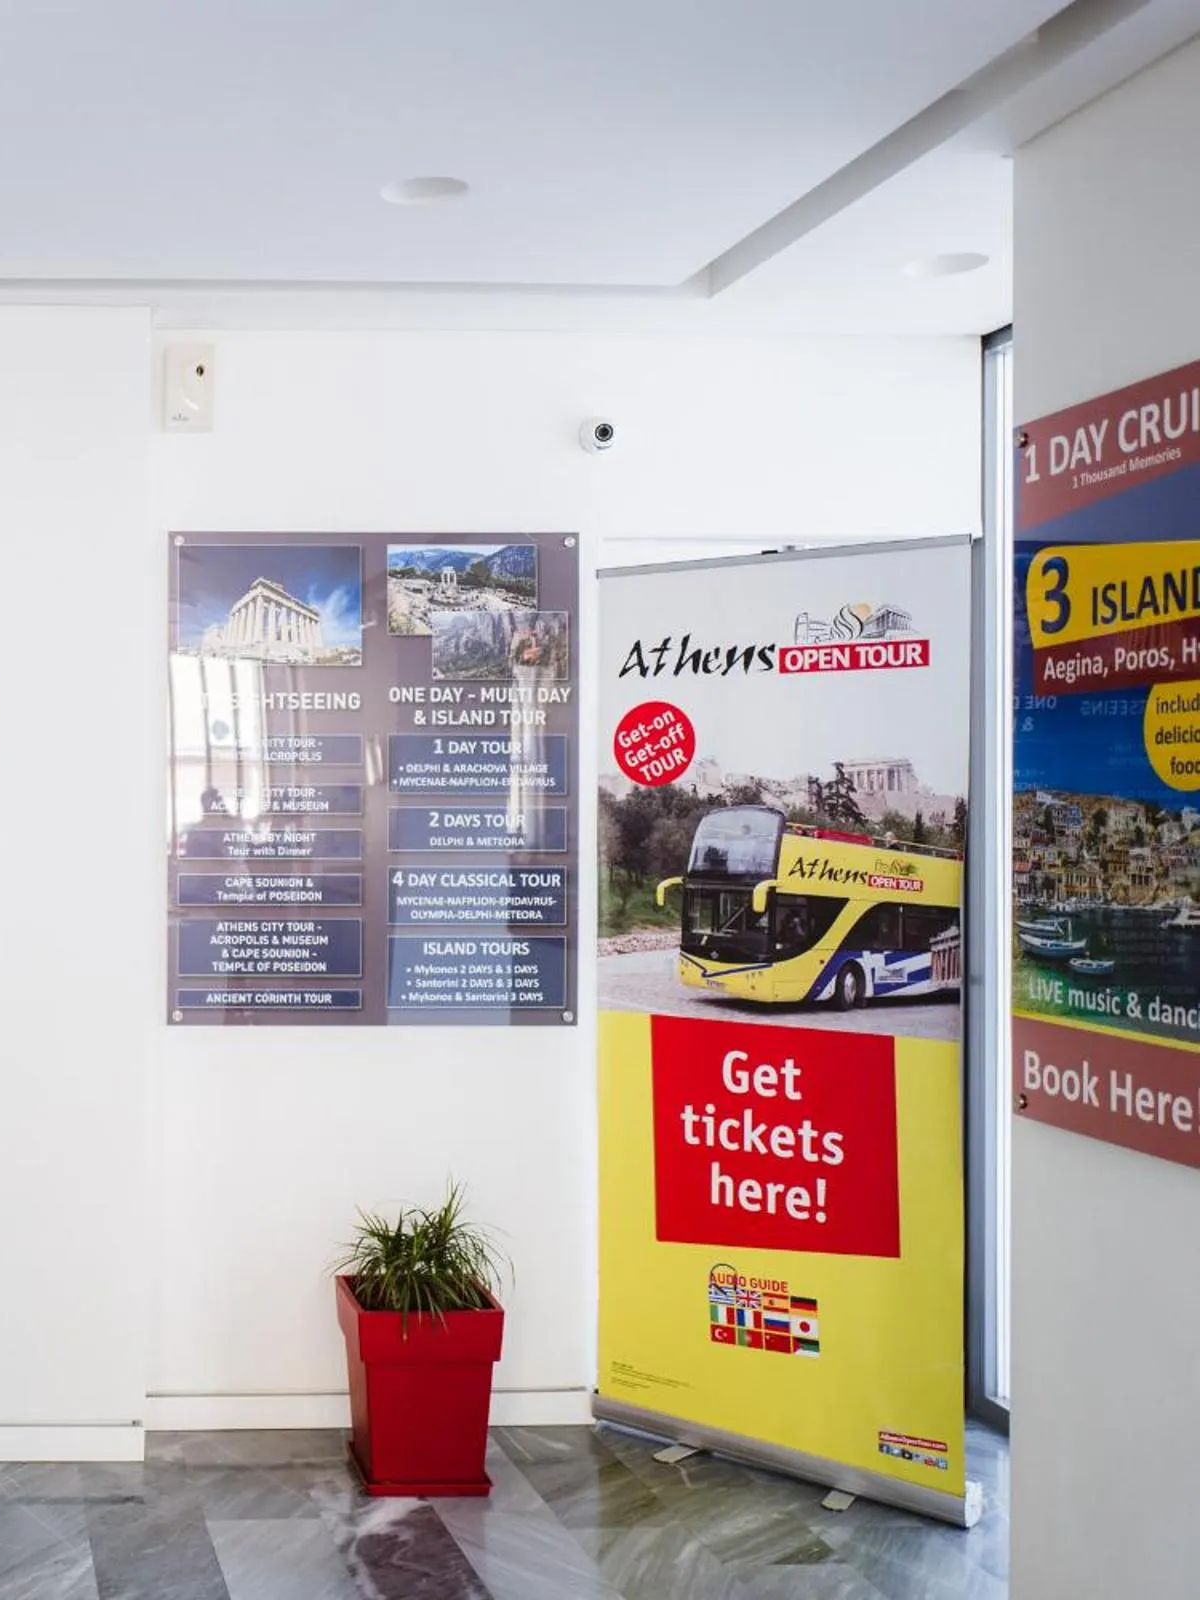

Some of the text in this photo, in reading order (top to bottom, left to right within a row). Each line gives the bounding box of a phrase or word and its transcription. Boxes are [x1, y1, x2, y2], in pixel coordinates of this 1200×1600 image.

[1025, 387, 1200, 484] 1 DAY CRUI
[1080, 461, 1127, 486] Thousand
[1129, 447, 1182, 473] Memories
[1040, 556, 1072, 634] 3
[618, 633, 924, 679] Athens OPEN TOUR
[1043, 636, 1200, 684] Aegina, Poros, H
[389, 687, 425, 703] ONE
[430, 687, 464, 703] DAY
[481, 687, 531, 703] MULTI
[538, 687, 571, 703] DAY
[413, 710, 546, 725] & ISLAND TOUR
[618, 710, 676, 748] Get-on
[288, 738, 316, 747] TOUR
[433, 738, 522, 754] 1 DAY TOUR
[625, 723, 686, 767] Get-off
[263, 751, 322, 761] ACROPOLIS
[406, 763, 441, 773] DELPHI
[453, 763, 507, 773] ARACHOVA
[510, 763, 549, 774] VILLAGE
[639, 748, 688, 782] TOUR
[288, 788, 316, 797] TOUR
[283, 801, 329, 811] MUSEUM
[429, 812, 526, 828] 2 DAYS TOUR
[284, 833, 317, 843] NIGHT
[430, 836, 463, 846] DELPHI
[477, 836, 525, 846] METEORA
[228, 846, 249, 856] Tour
[253, 846, 276, 856] with
[392, 871, 561, 887] 4 DAY CLASSICAL TOUR
[788, 857, 922, 890] Athens OPEN TOUR
[225, 878, 253, 888] CAPE
[255, 878, 304, 888] SOUNION
[216, 891, 322, 902] Temple of POSEIDON
[216, 922, 259, 932] ATHENS
[261, 922, 284, 932] CITY
[287, 922, 315, 932] TOUR
[210, 935, 270, 945] ACROPOLIS
[282, 935, 329, 945] MUSEUM
[232, 948, 259, 958] CAPE
[261, 948, 310, 958] SOUNION
[423, 942, 531, 955] ISLAND TOURS
[212, 962, 327, 972] TEMPLE OF POSEIDON
[414, 965, 458, 976] Mykonos
[468, 965, 493, 974] DAYS
[514, 965, 539, 974] DAYS
[415, 978, 459, 988] Santorini
[470, 978, 493, 987] DAYS
[515, 978, 540, 988] DAYS
[206, 993, 332, 1004] ANCIENT CORINTH TOUR
[408, 992, 452, 1002] Mykonos
[465, 992, 509, 1001] Santorini
[519, 992, 544, 1001] DAYS
[1029, 976, 1063, 1004] LIVE
[1068, 988, 1121, 1015] music
[1126, 992, 1142, 1019] &
[722, 1050, 802, 1101] Get
[1024, 1049, 1099, 1108] Book
[680, 1104, 845, 1166] tickets
[710, 1162, 828, 1224] here!
[711, 1272, 789, 1293] AUDIO GUIDE
